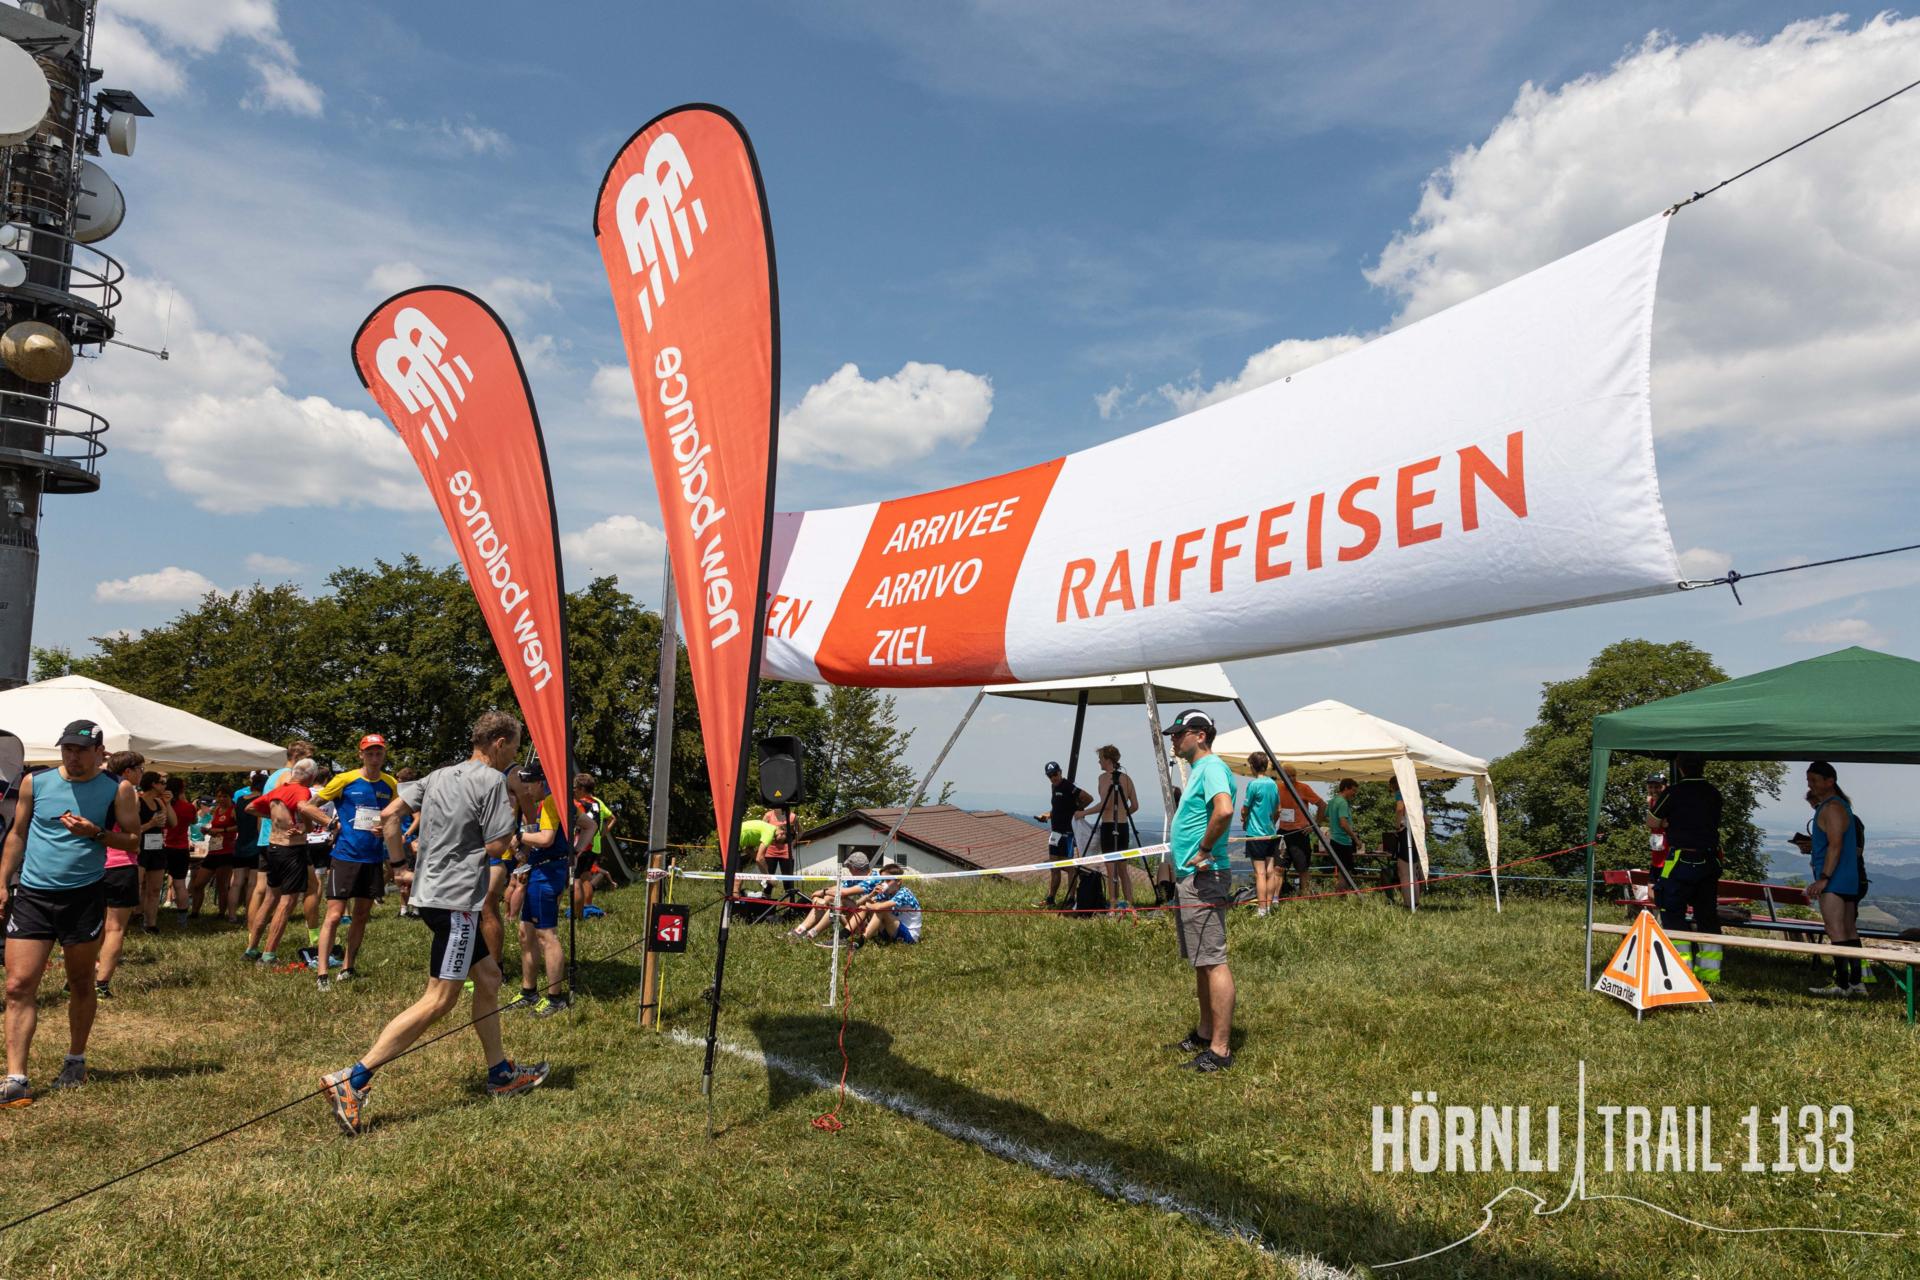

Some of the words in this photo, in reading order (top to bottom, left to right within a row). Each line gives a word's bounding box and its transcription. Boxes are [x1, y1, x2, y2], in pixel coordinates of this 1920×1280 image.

[882, 496, 1020, 555] ARRIVEE
[1056, 430, 1528, 624] RAIFFEISEN
[866, 557, 983, 609] ARRIVO
[868, 625, 933, 666] ZIEL
[452, 923, 470, 973] HUSTECH
[1600, 977, 1636, 1003] Samariter
